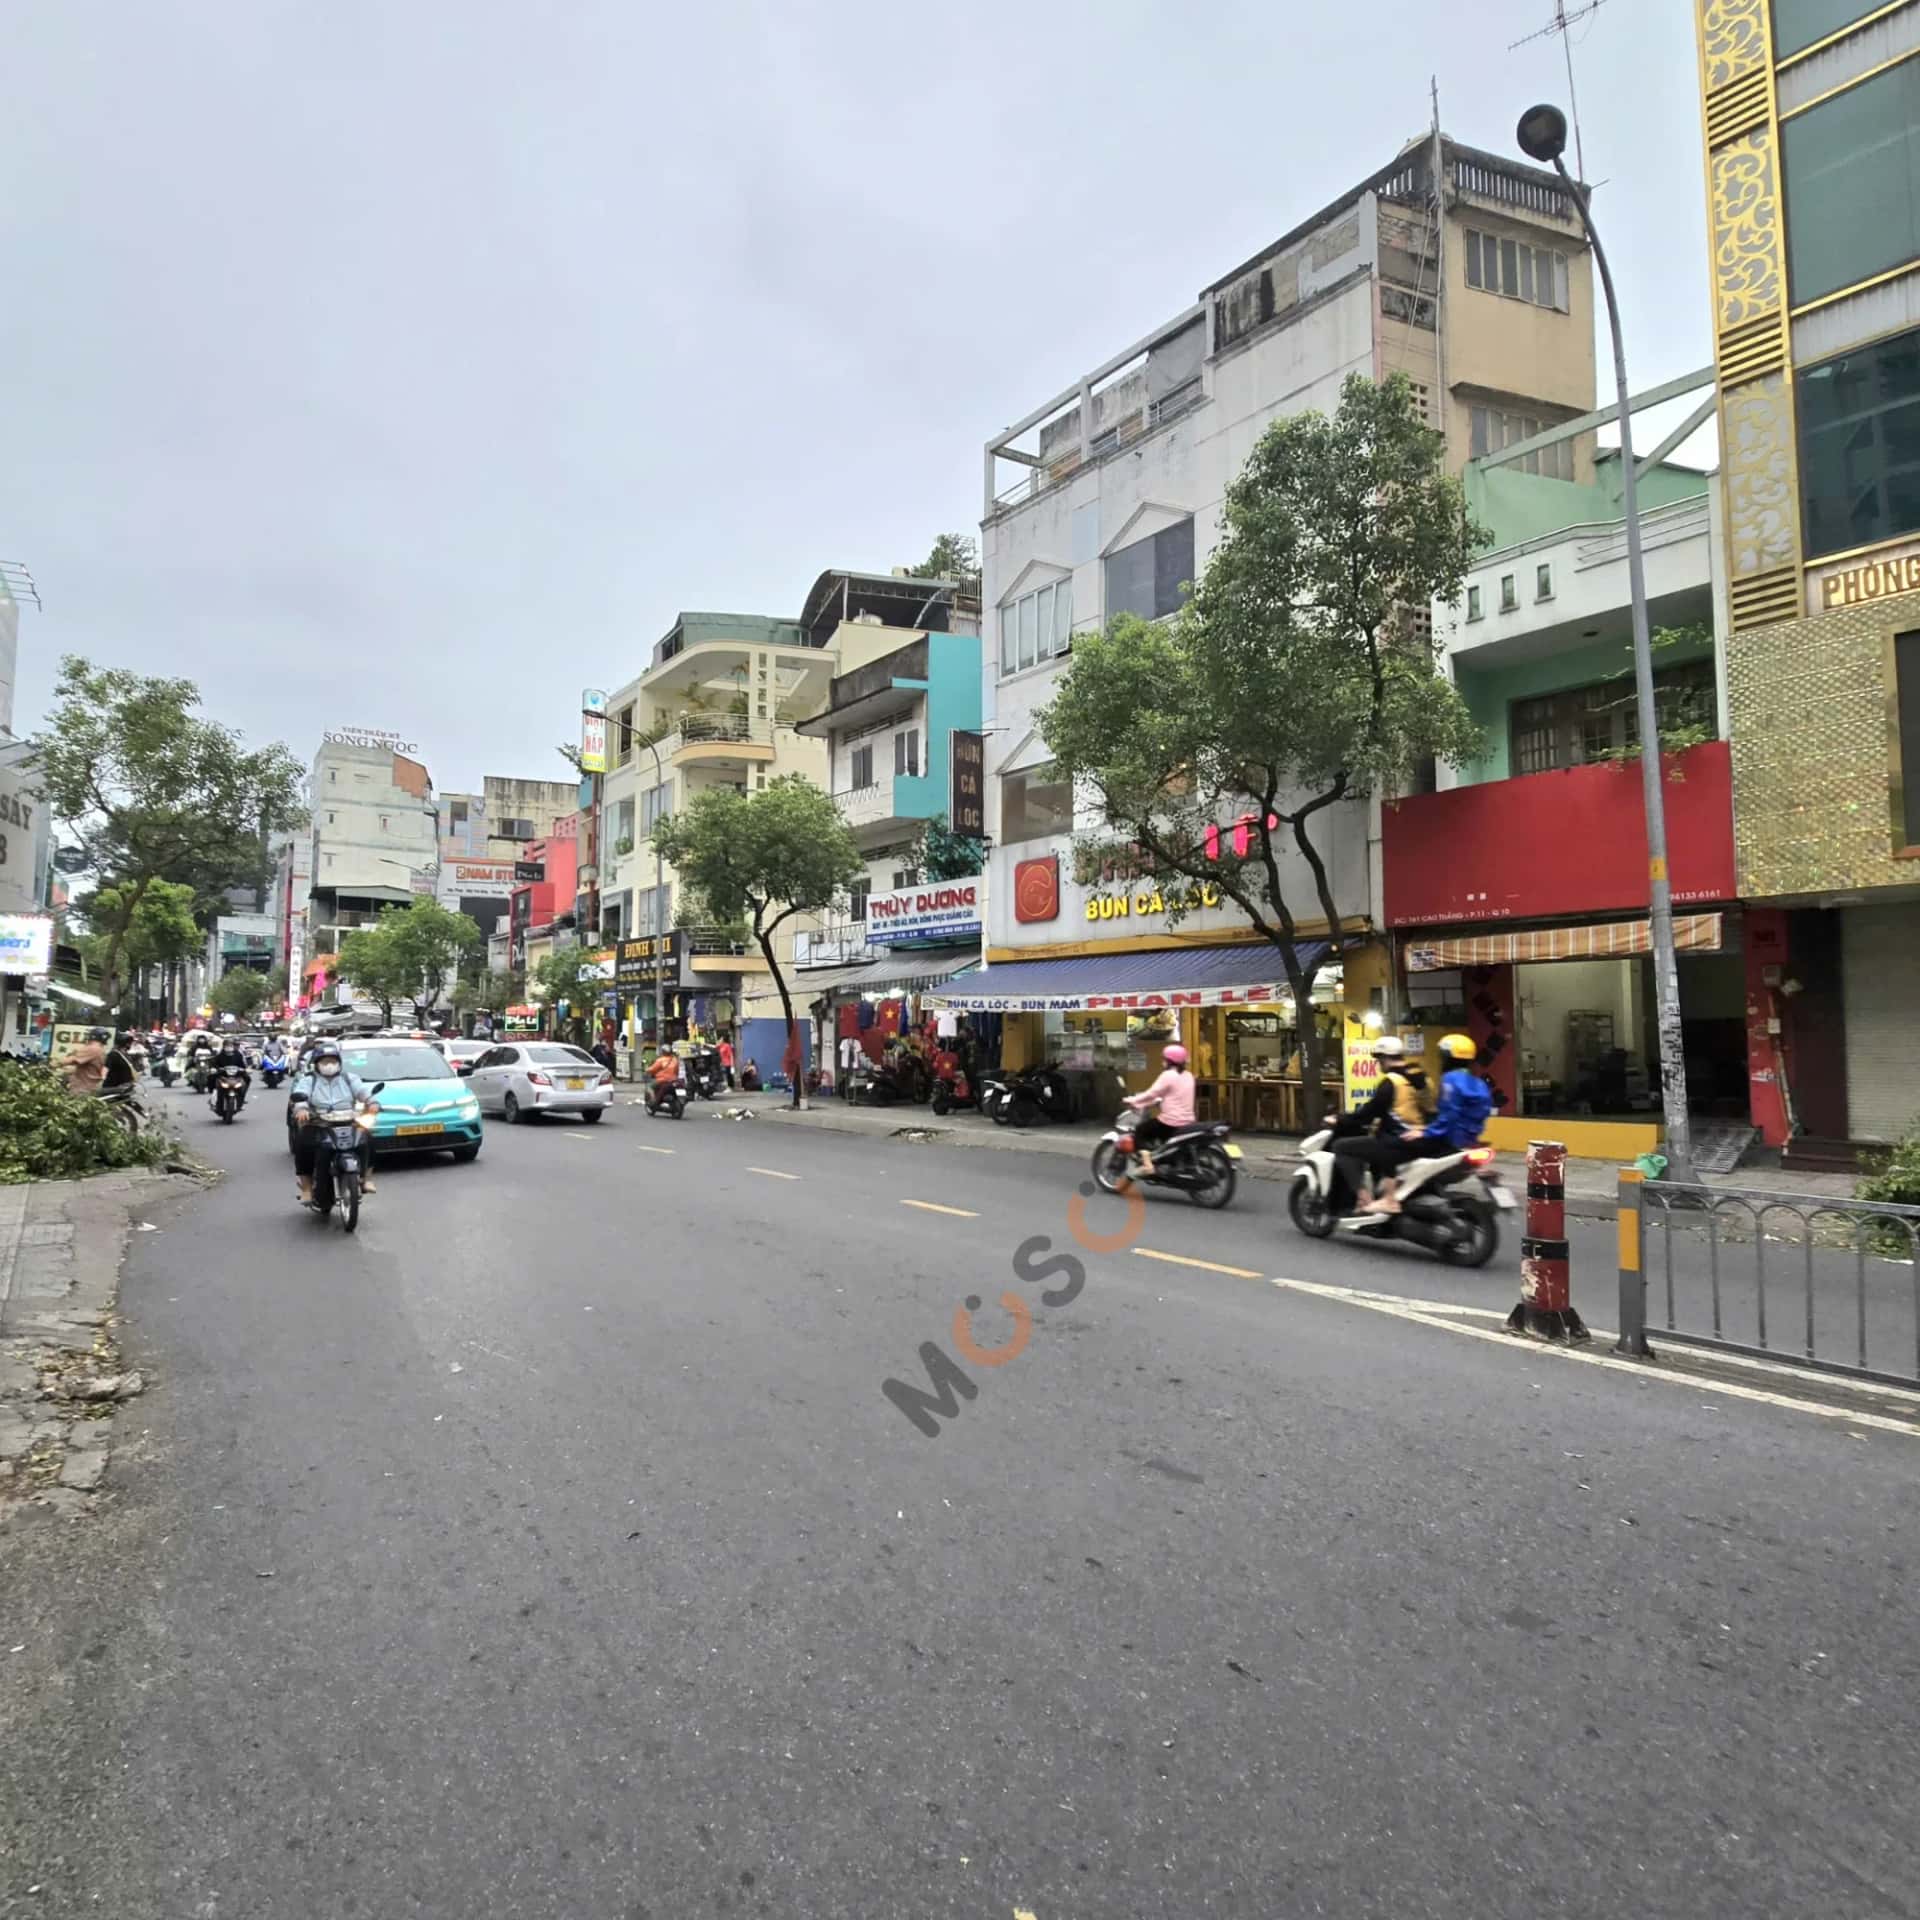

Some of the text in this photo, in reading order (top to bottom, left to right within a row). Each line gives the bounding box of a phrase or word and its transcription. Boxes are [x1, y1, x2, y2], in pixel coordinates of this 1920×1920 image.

[323, 731, 369, 749] SONG
[869, 886, 977, 918] THÙY DƯƠNG
[1086, 991, 1202, 1009] PHAN
[1351, 1059, 1377, 1078] 40K
